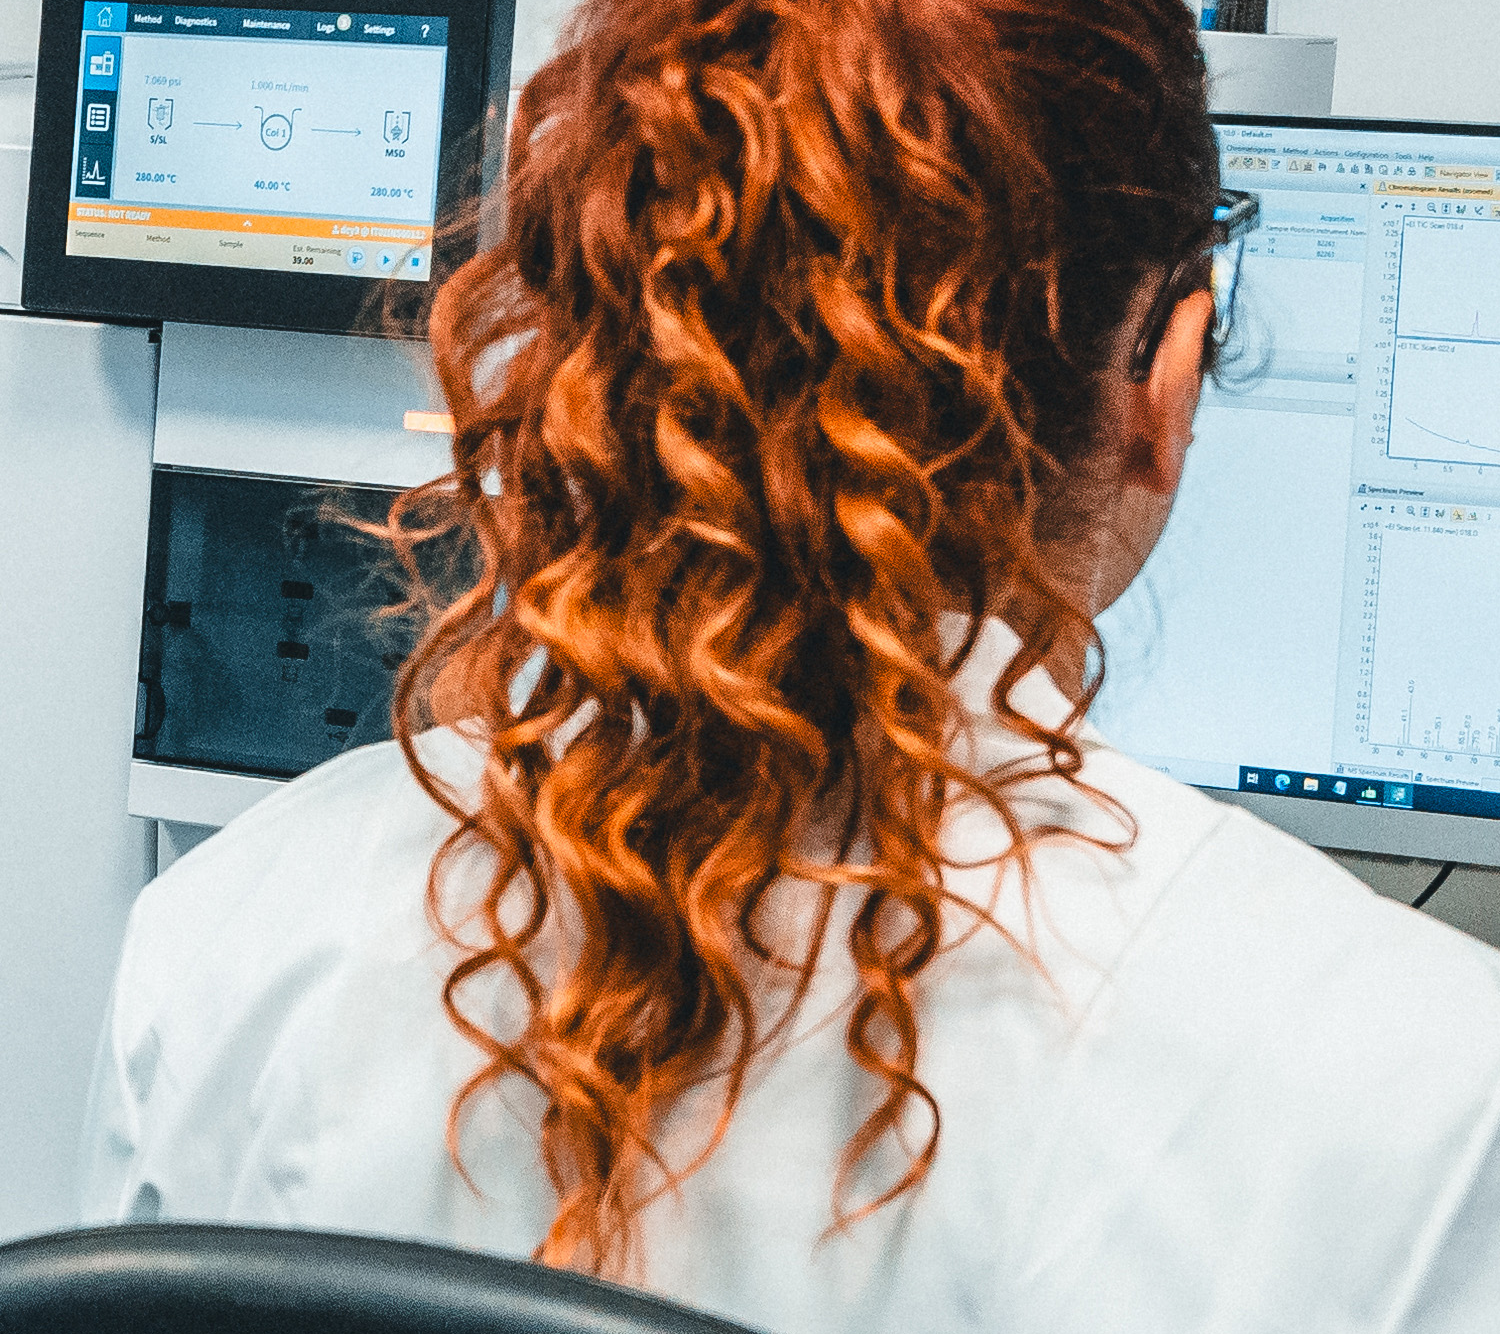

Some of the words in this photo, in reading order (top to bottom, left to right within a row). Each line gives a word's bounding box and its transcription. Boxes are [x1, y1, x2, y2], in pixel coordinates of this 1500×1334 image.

[133, 13, 162, 25] Method
[174, 16, 218, 27] Diagnostics
[242, 18, 291, 30] Maintenance
[316, 21, 336, 34] Logs
[363, 23, 396, 37] Settings
[168, 77, 182, 88] psi
[275, 81, 309, 94] mL/min
[265, 128, 279, 138] Col
[384, 148, 406, 158] MSD
[1282, 146, 1309, 156] Method
[1314, 148, 1339, 157] Actions
[1344, 150, 1390, 160] Configuration
[1395, 152, 1413, 160] Tools
[1418, 153, 1435, 162] Help
[135, 171, 165, 183] 280.00
[166, 173, 177, 184] °C
[1439, 168, 1472, 179] Navigator
[1473, 170, 1489, 179] View
[253, 179, 279, 191] 40.00
[280, 181, 291, 192] °C
[370, 186, 402, 198] 280.00
[403, 189, 414, 199] °C
[107, 209, 125, 219] NOT
[125, 210, 152, 221] READY
[1430, 222, 1446, 230] Scan
[75, 229, 106, 240] Sequence
[146, 234, 172, 244] Method
[218, 239, 244, 249] Sample
[306, 245, 342, 257] Remaining
[292, 255, 314, 265] 39.00
[1367, 485, 1398, 496] Spectrum
[1398, 488, 1425, 497] Preview
[1396, 524, 1412, 532] Scan
[1426, 774, 1454, 784] Spectrum
